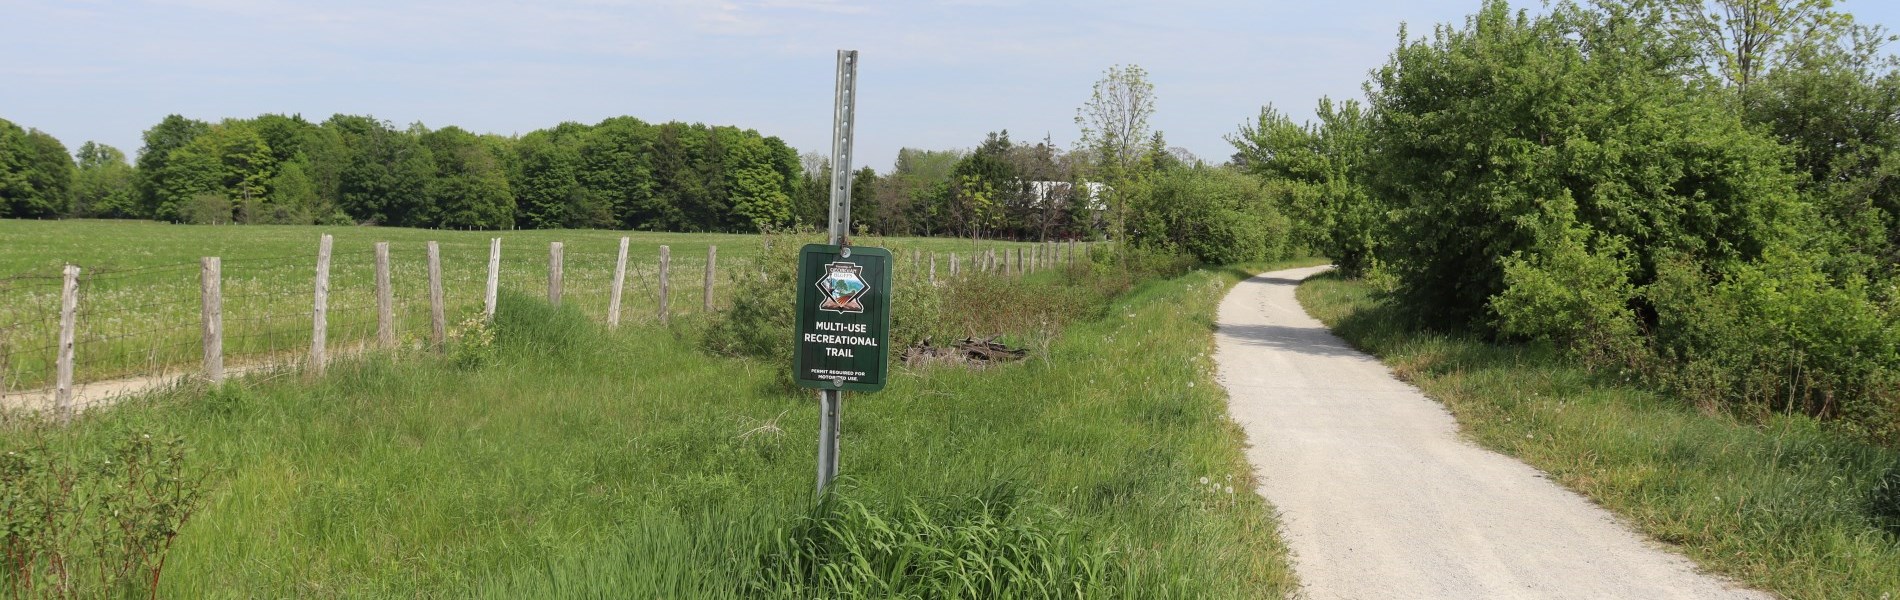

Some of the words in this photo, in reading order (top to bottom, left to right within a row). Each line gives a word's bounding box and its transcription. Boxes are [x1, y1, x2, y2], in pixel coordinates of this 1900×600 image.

[815, 321, 867, 333] MULTI-USE
[804, 333, 878, 346] RECREATIONAL
[825, 347, 854, 358] TRAIL
